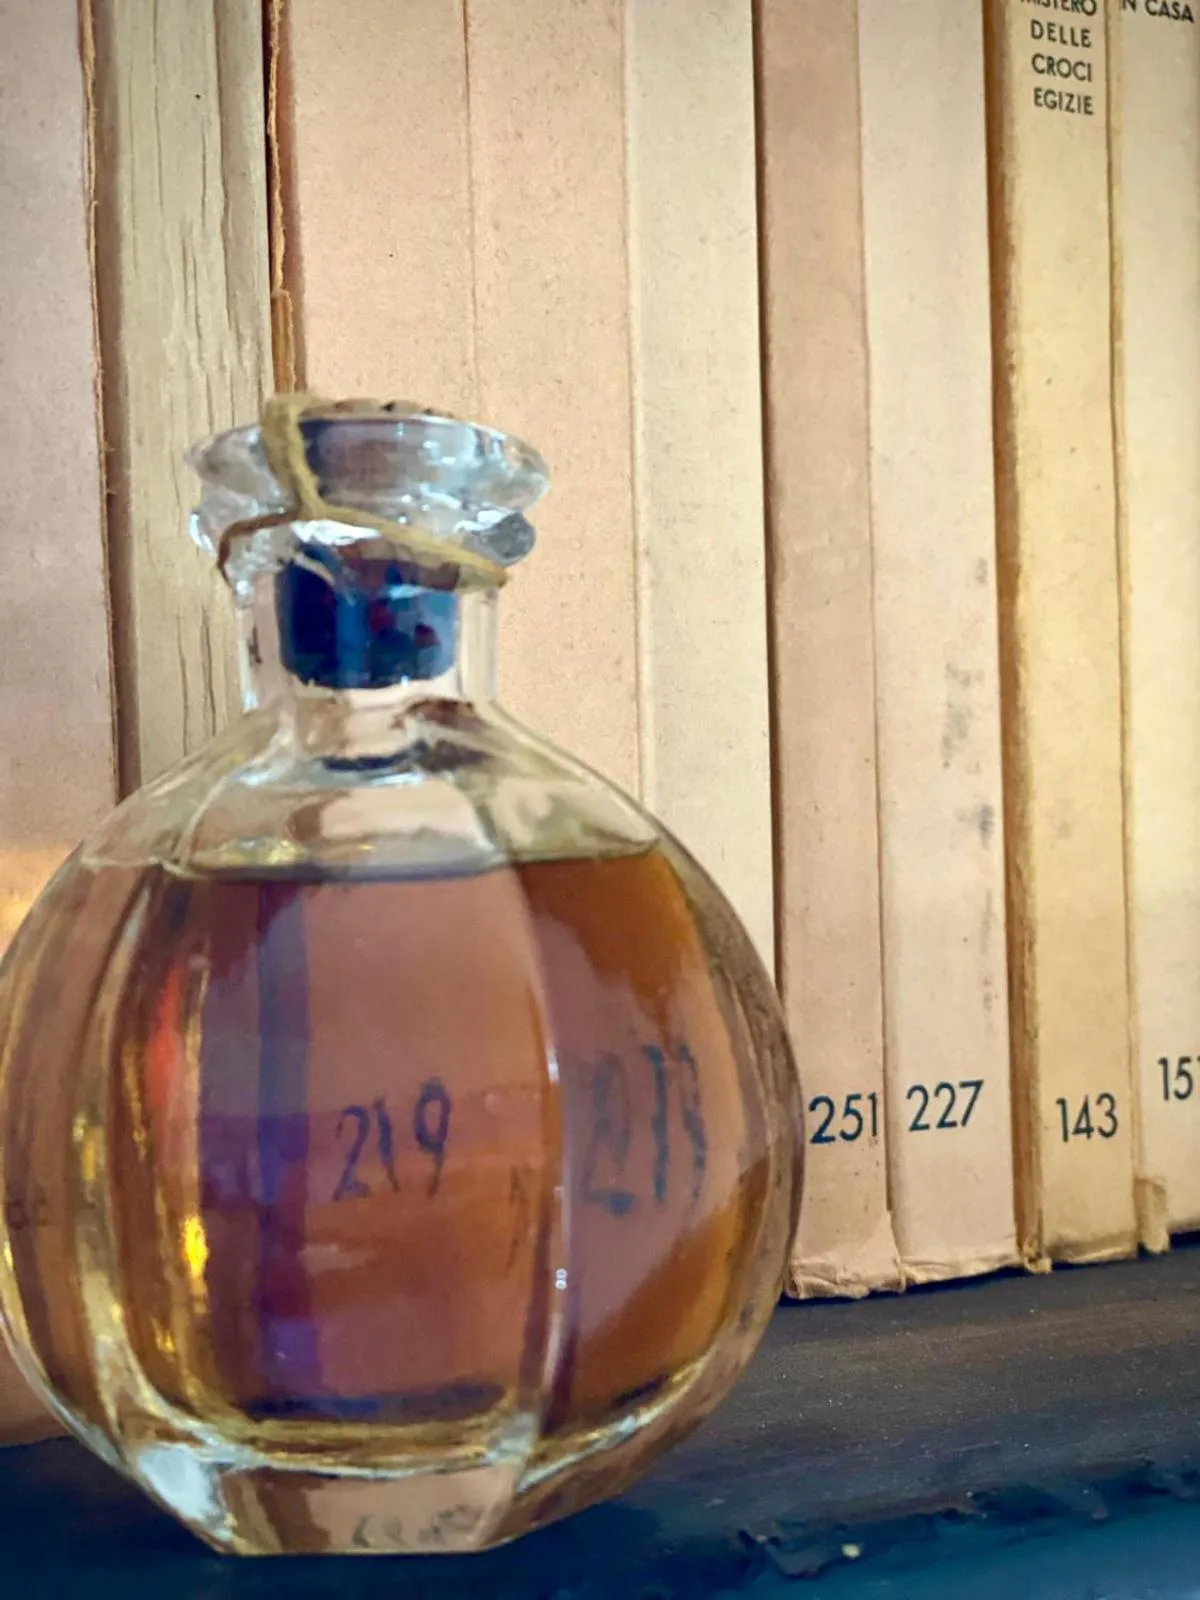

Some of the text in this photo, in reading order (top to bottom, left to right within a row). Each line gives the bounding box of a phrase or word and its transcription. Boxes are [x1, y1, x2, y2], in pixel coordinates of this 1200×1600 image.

[1031, 19, 1091, 48] DELLE
[1145, 0, 1196, 24] CASA
[1031, 53, 1092, 82] CROCI
[1033, 87, 1094, 116] EGIZIE
[1157, 1056, 1200, 1101] 15
[808, 1091, 879, 1145] 251
[906, 1079, 984, 1132] 227
[1055, 1092, 1119, 1143] 143
[332, 1076, 452, 1202] 219
